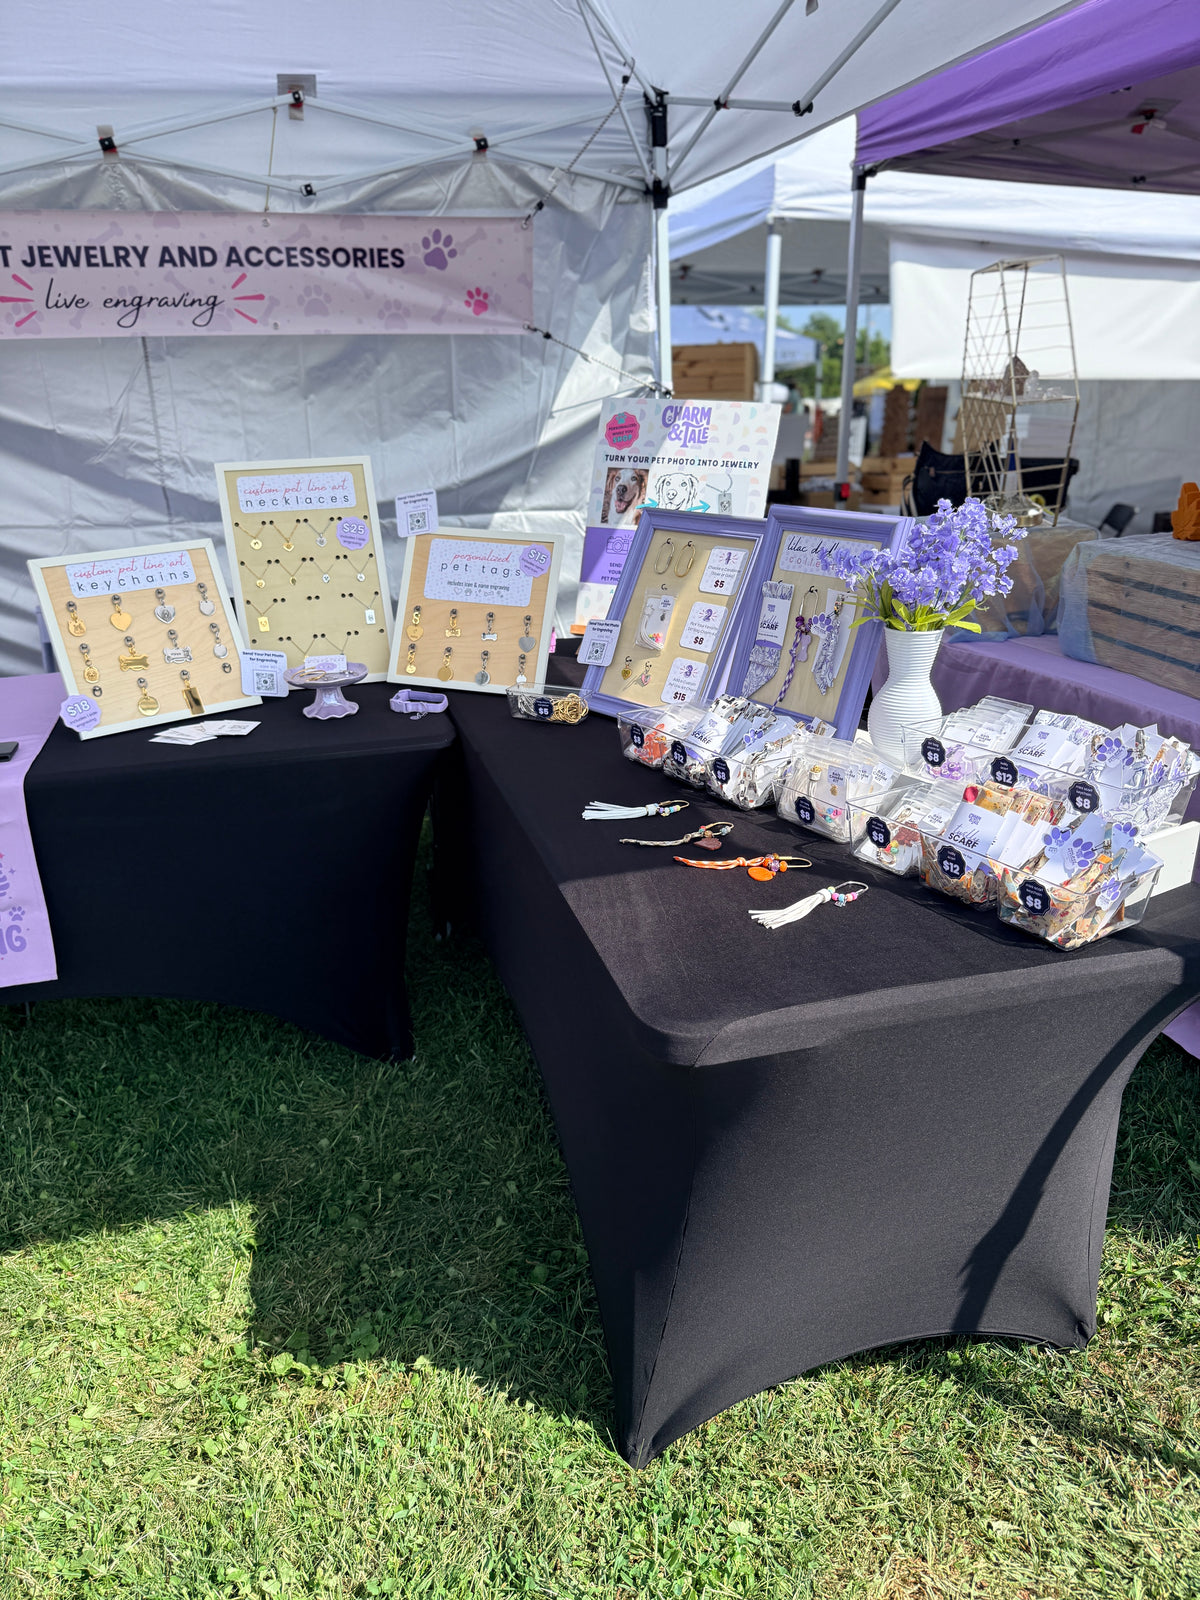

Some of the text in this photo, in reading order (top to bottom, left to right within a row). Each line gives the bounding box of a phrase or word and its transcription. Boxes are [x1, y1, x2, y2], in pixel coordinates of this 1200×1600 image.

[21, 245, 149, 268] JEWELRY
[158, 245, 218, 268] AND
[225, 246, 405, 269] ACCESSORIES
[45, 277, 224, 328] live engraving
[662, 405, 713, 428] CHARM
[612, 434, 633, 444] SHOP
[604, 454, 760, 470] TURN YOUR PET PHOTO INTO JEWELRY
[244, 477, 348, 499] custom pet line art
[245, 494, 350, 508] necklaces
[343, 521, 366, 535] $25
[787, 536, 808, 552] lilac
[450, 549, 513, 565] personalized
[528, 549, 548, 565] $15
[73, 552, 187, 580] custom pet line art
[440, 562, 469, 572] pet
[481, 564, 521, 578] tags
[76, 570, 190, 592] keychains
[713, 579, 725, 589] $5
[702, 608, 713, 622] 2
[760, 621, 779, 631] SCARF
[693, 636, 705, 646] $8
[684, 664, 694, 678] 3
[672, 691, 687, 702] $15
[66, 699, 91, 717] $18
[538, 707, 549, 715] $5
[633, 734, 642, 745] $8
[691, 730, 712, 745] SCARF
[673, 751, 685, 764] $12
[926, 751, 940, 762] $8
[1017, 748, 1046, 759] SCARF
[716, 770, 726, 780] $8
[995, 772, 1013, 784] $12
[1075, 797, 1091, 809] $8
[800, 809, 811, 820] $8
[872, 830, 884, 843] $8
[948, 832, 979, 849] SCARF
[942, 859, 960, 875] $12
[1025, 895, 1042, 910] $8
